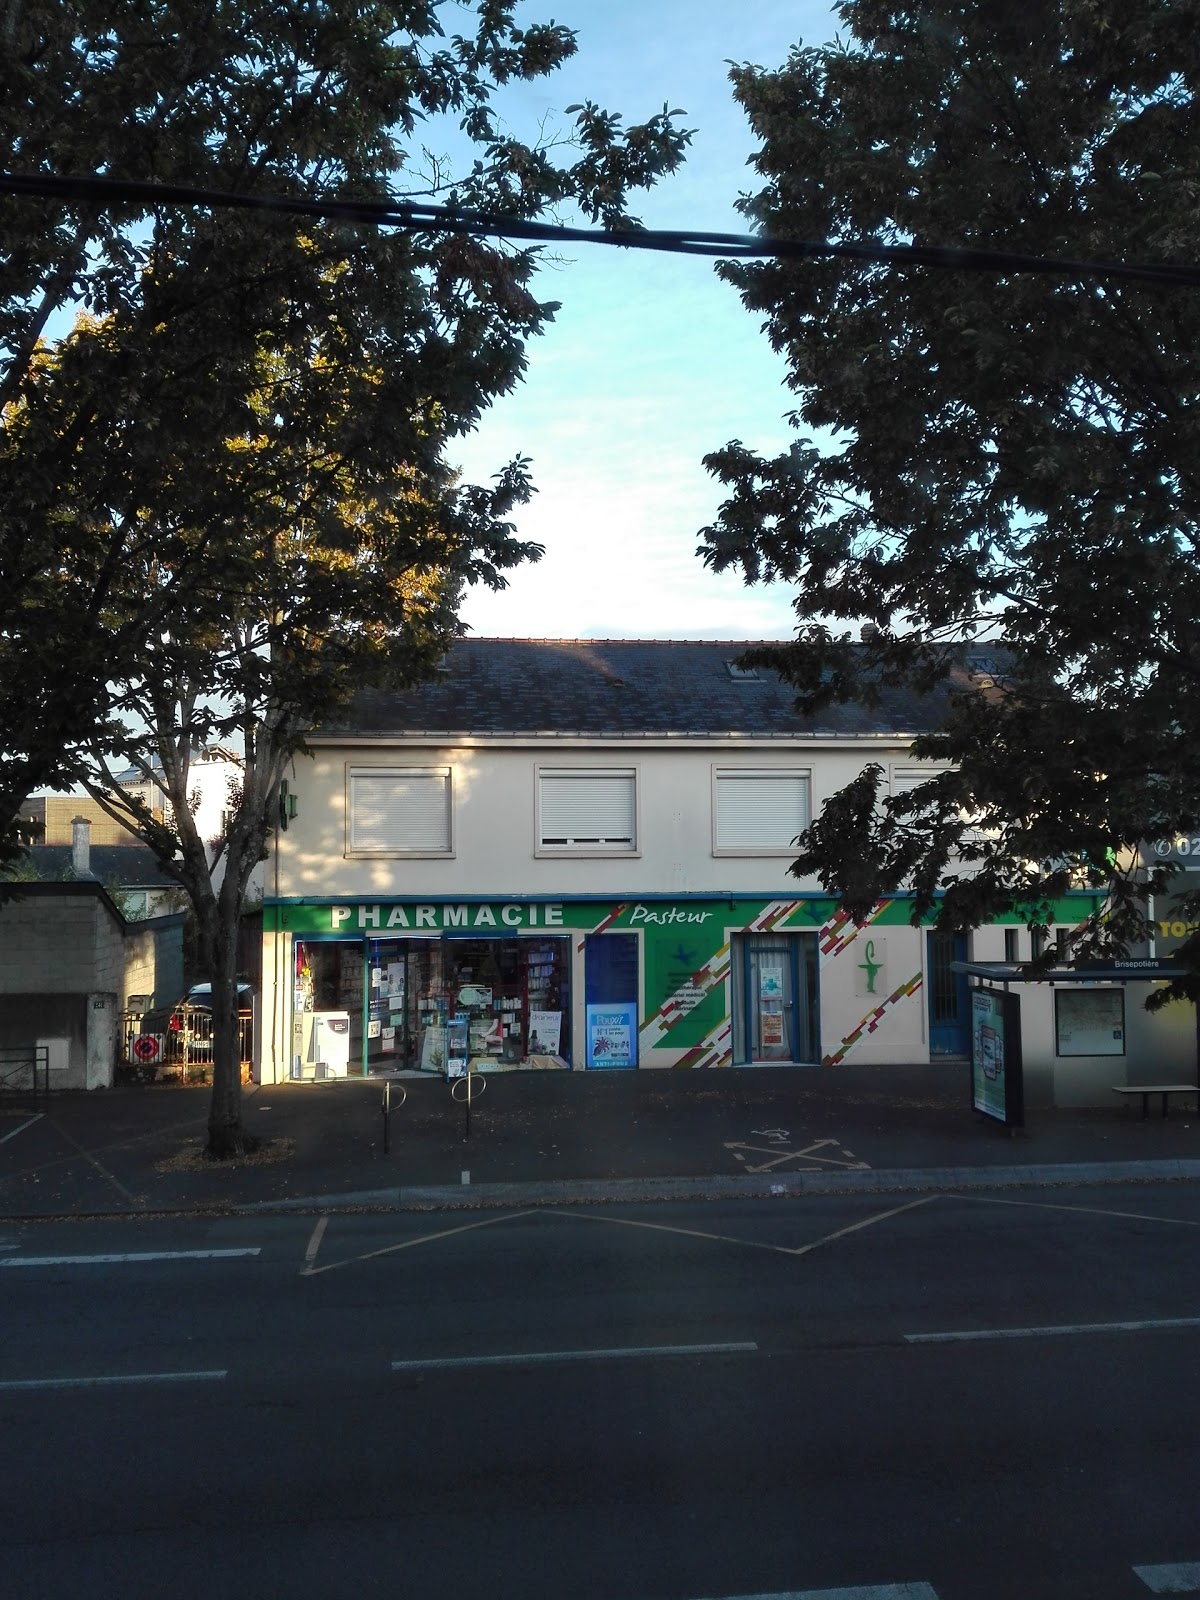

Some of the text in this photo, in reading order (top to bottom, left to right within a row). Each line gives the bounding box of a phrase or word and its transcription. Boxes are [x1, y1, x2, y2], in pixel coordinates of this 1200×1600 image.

[1177, 837, 1200, 856] 02
[331, 903, 564, 929] PHARMACIE
[629, 904, 714, 926] Pasteur
[1114, 960, 1159, 969] Brisepotière
